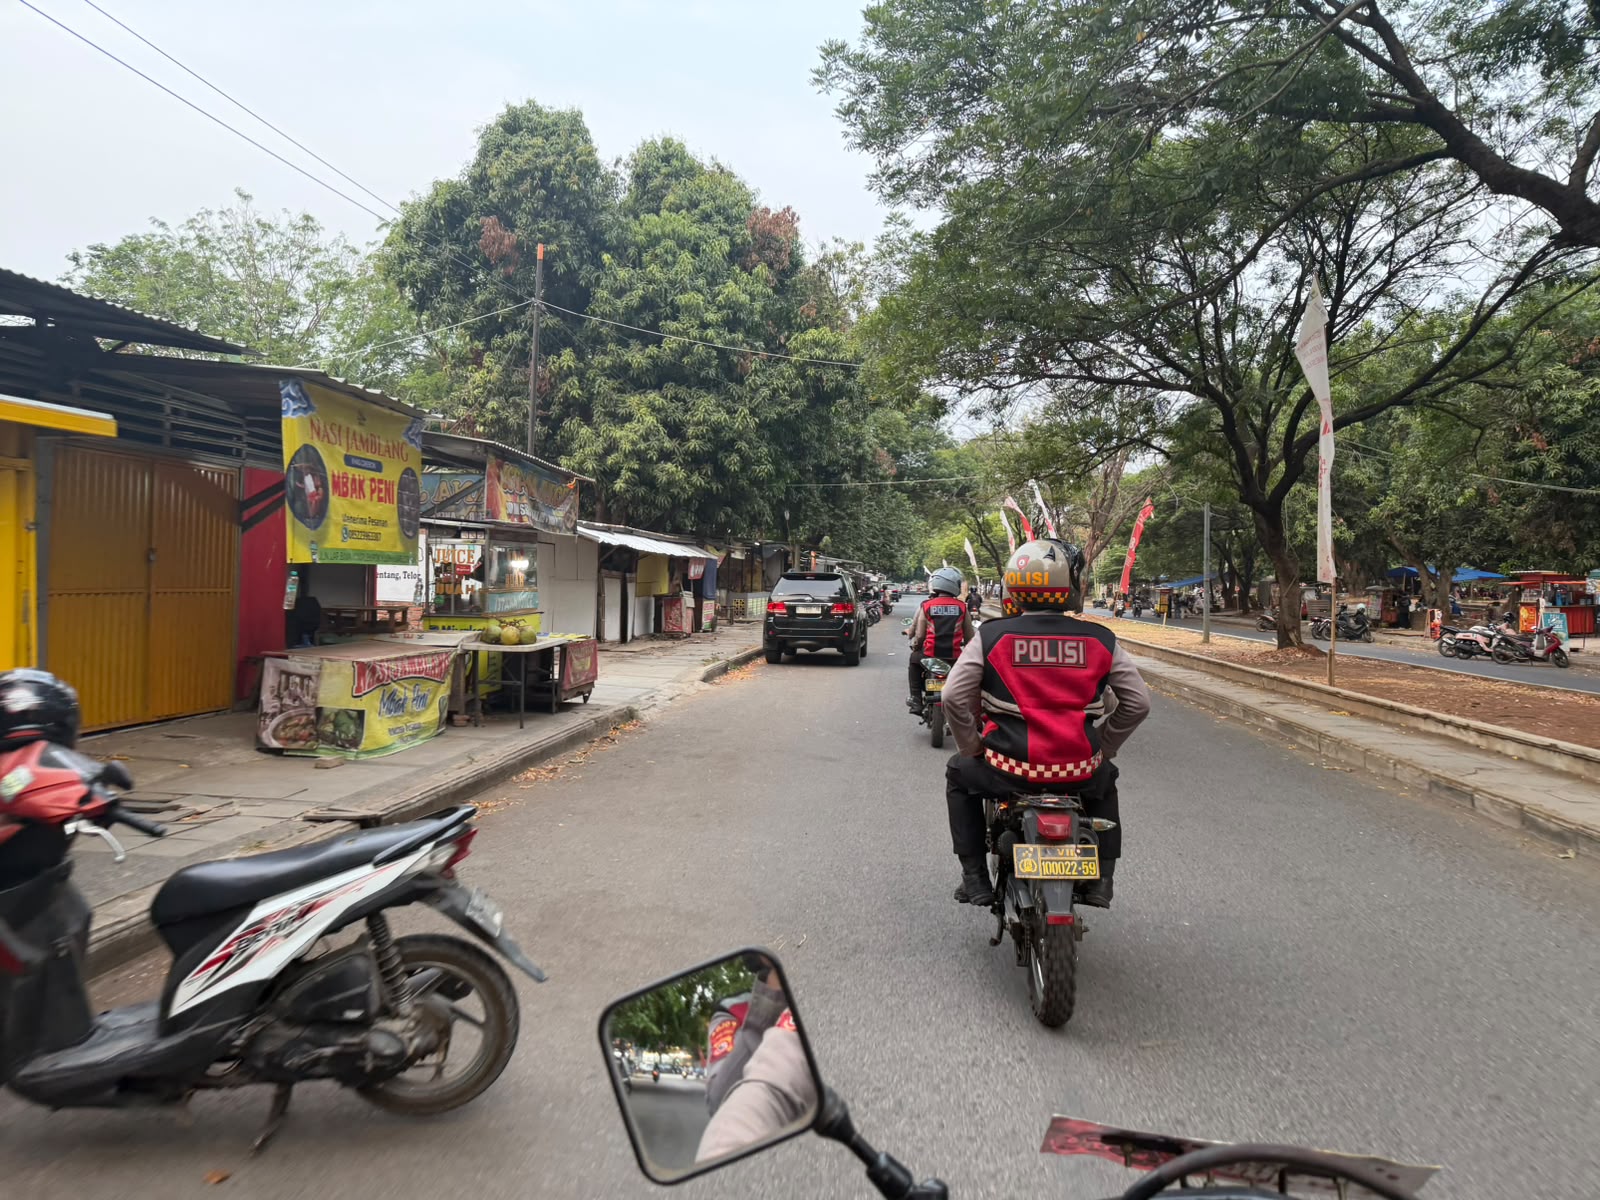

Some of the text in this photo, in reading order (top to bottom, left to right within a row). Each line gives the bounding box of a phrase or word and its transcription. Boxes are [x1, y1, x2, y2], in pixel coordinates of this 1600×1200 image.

[309, 418, 343, 446] NASI
[331, 470, 395, 505] MBAK PENI
[433, 548, 475, 564] JUICE
[1015, 640, 1084, 664] POLISI
